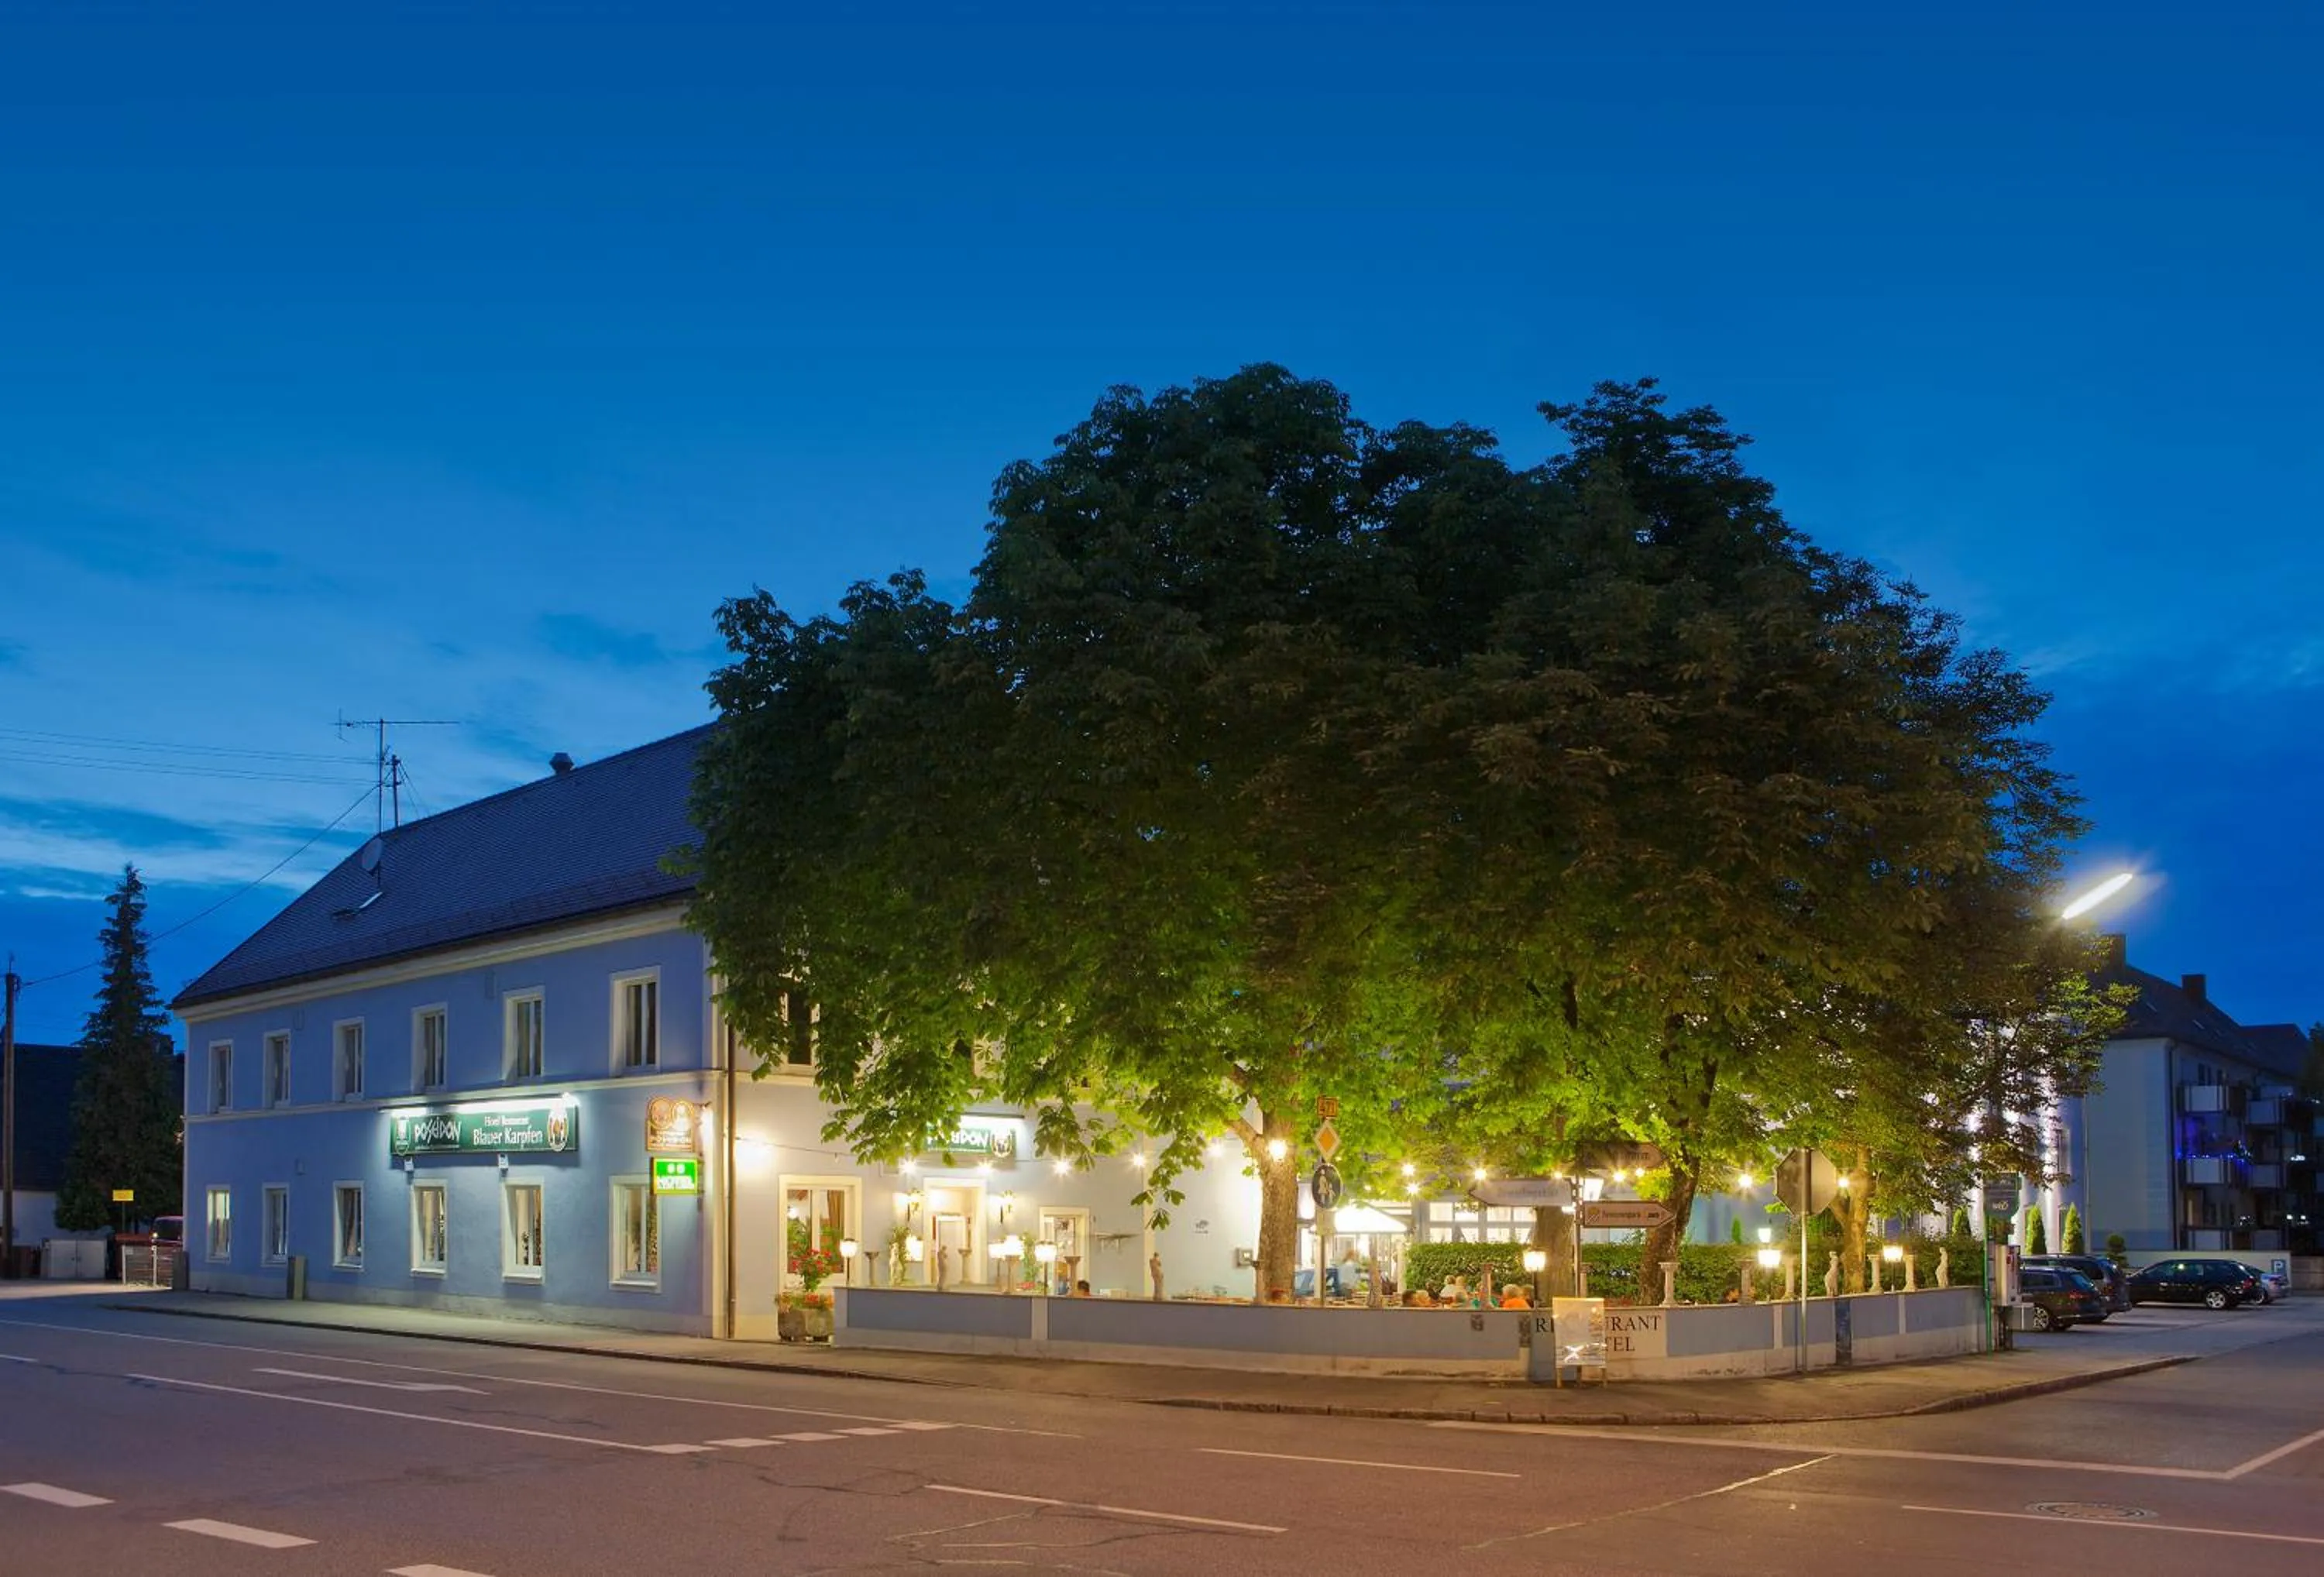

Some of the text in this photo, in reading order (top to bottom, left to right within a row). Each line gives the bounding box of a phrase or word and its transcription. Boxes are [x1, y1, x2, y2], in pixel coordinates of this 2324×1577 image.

[414, 1116, 462, 1144] POSEIDON
[473, 1124, 543, 1149] Blauer Karpfen
[2274, 1260, 2284, 1273] P
[1535, 1315, 1662, 1334] RRANT
